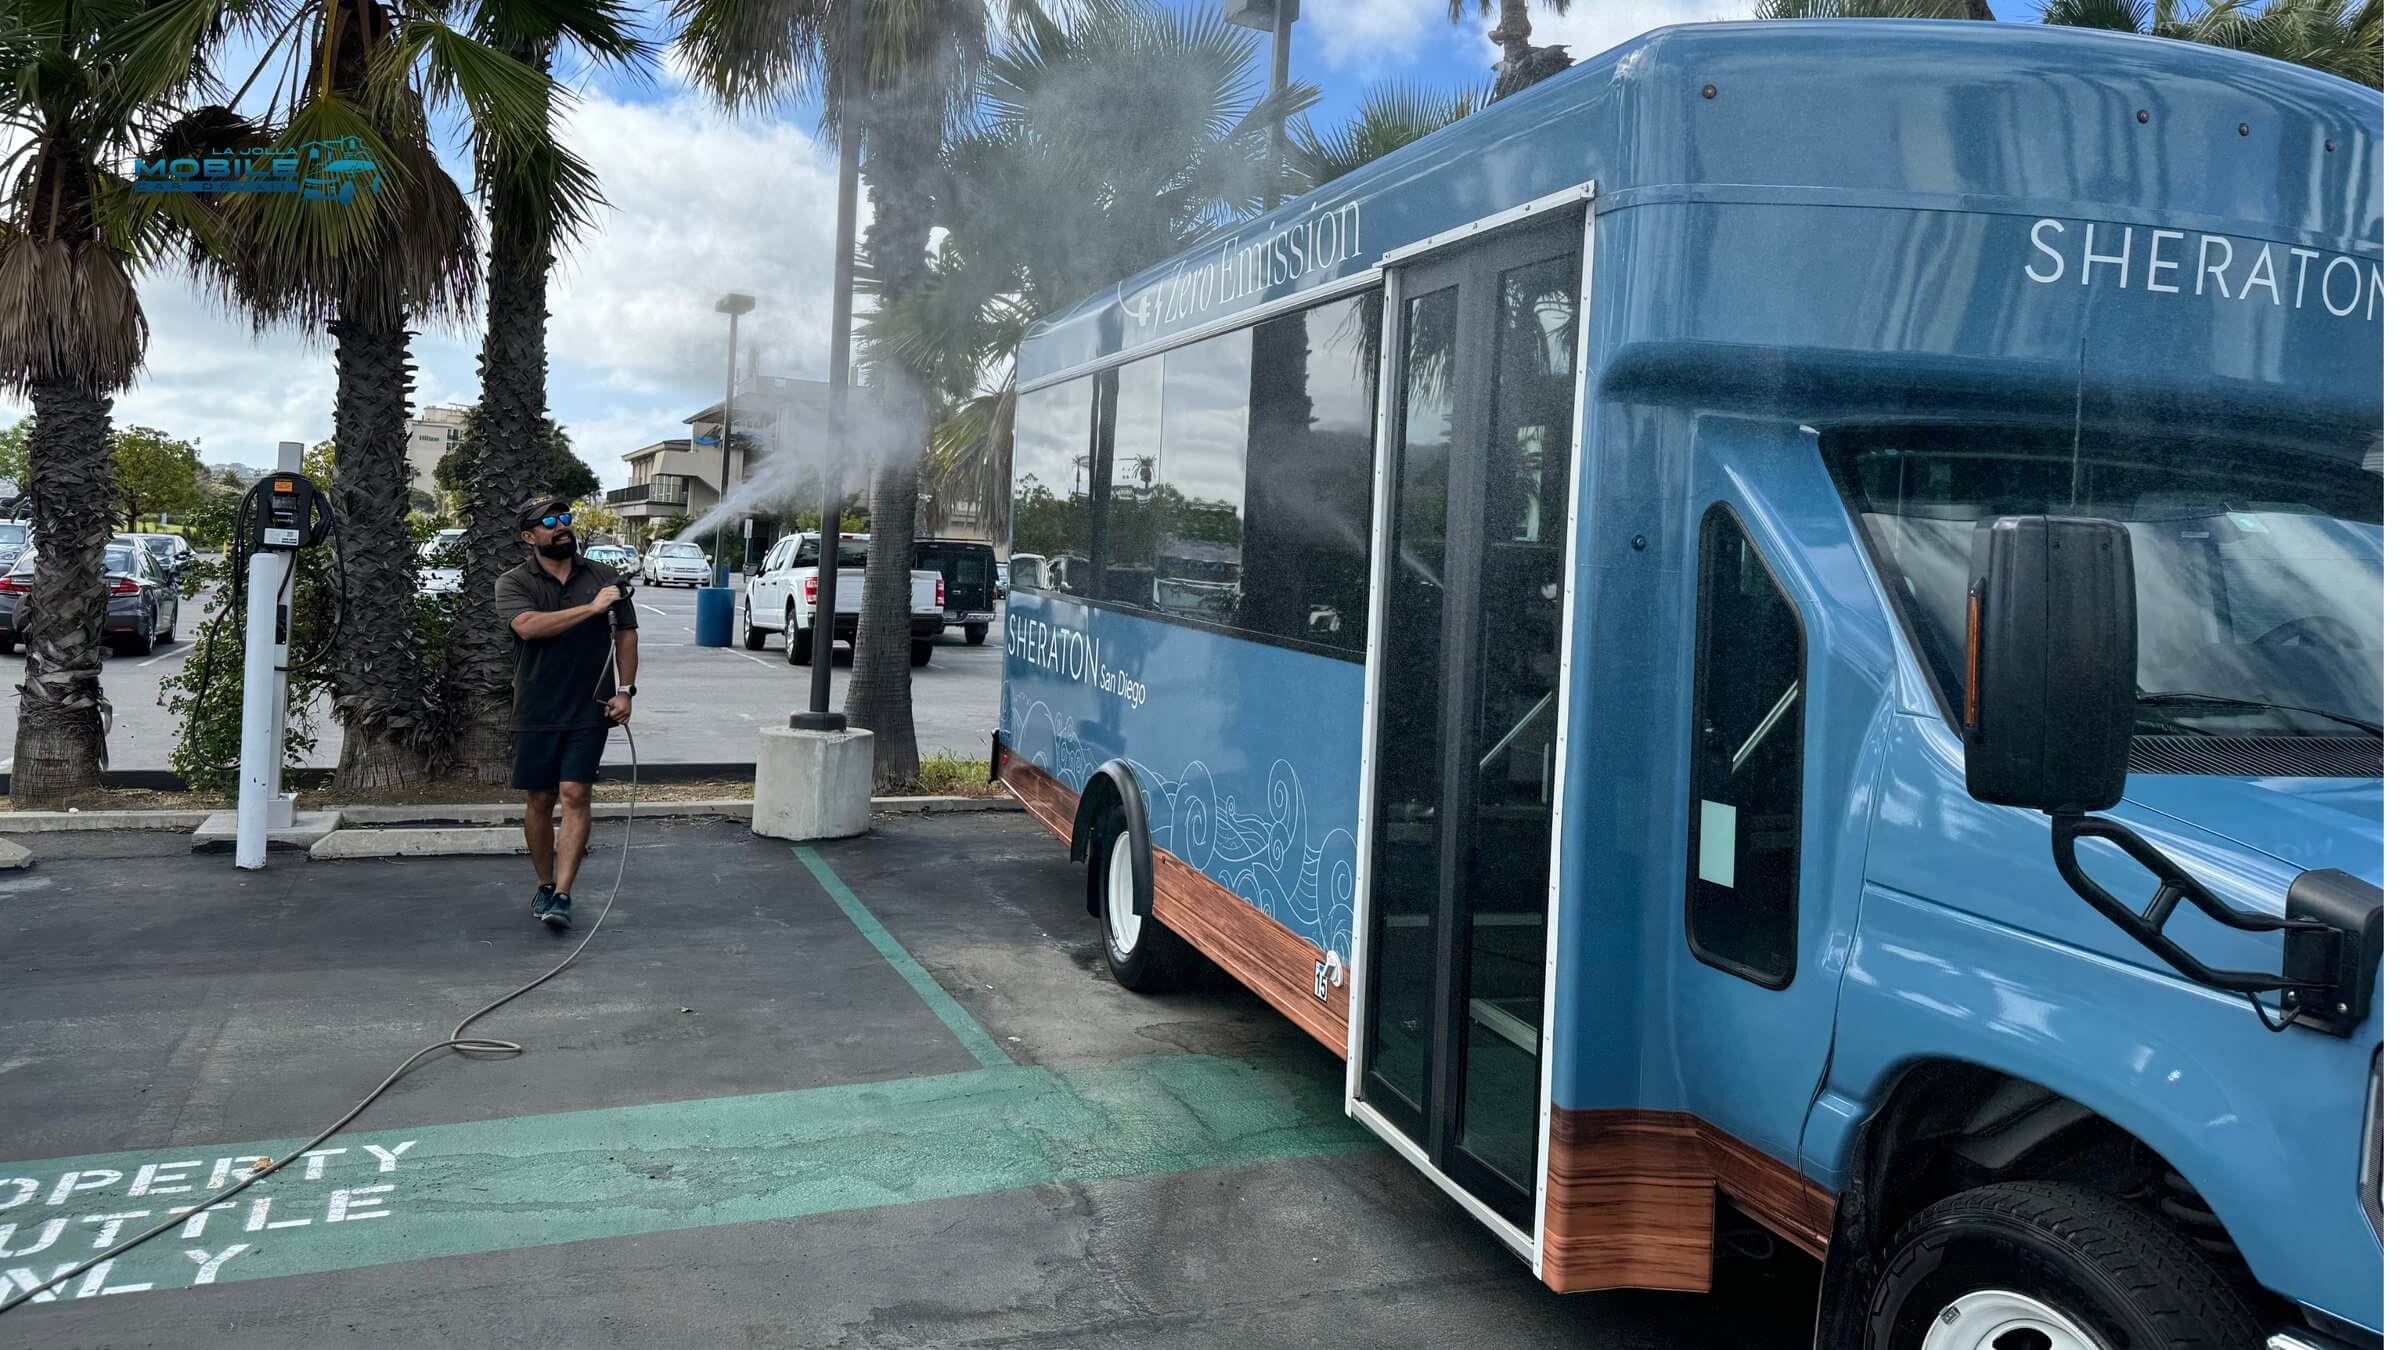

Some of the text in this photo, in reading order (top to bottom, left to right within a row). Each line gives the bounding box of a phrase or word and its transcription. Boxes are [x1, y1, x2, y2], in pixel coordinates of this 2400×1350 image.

[1164, 200, 1363, 324] Zero Emission
[1008, 613, 1146, 709] SHERATON San Diego
[1316, 972, 1327, 998] 15
